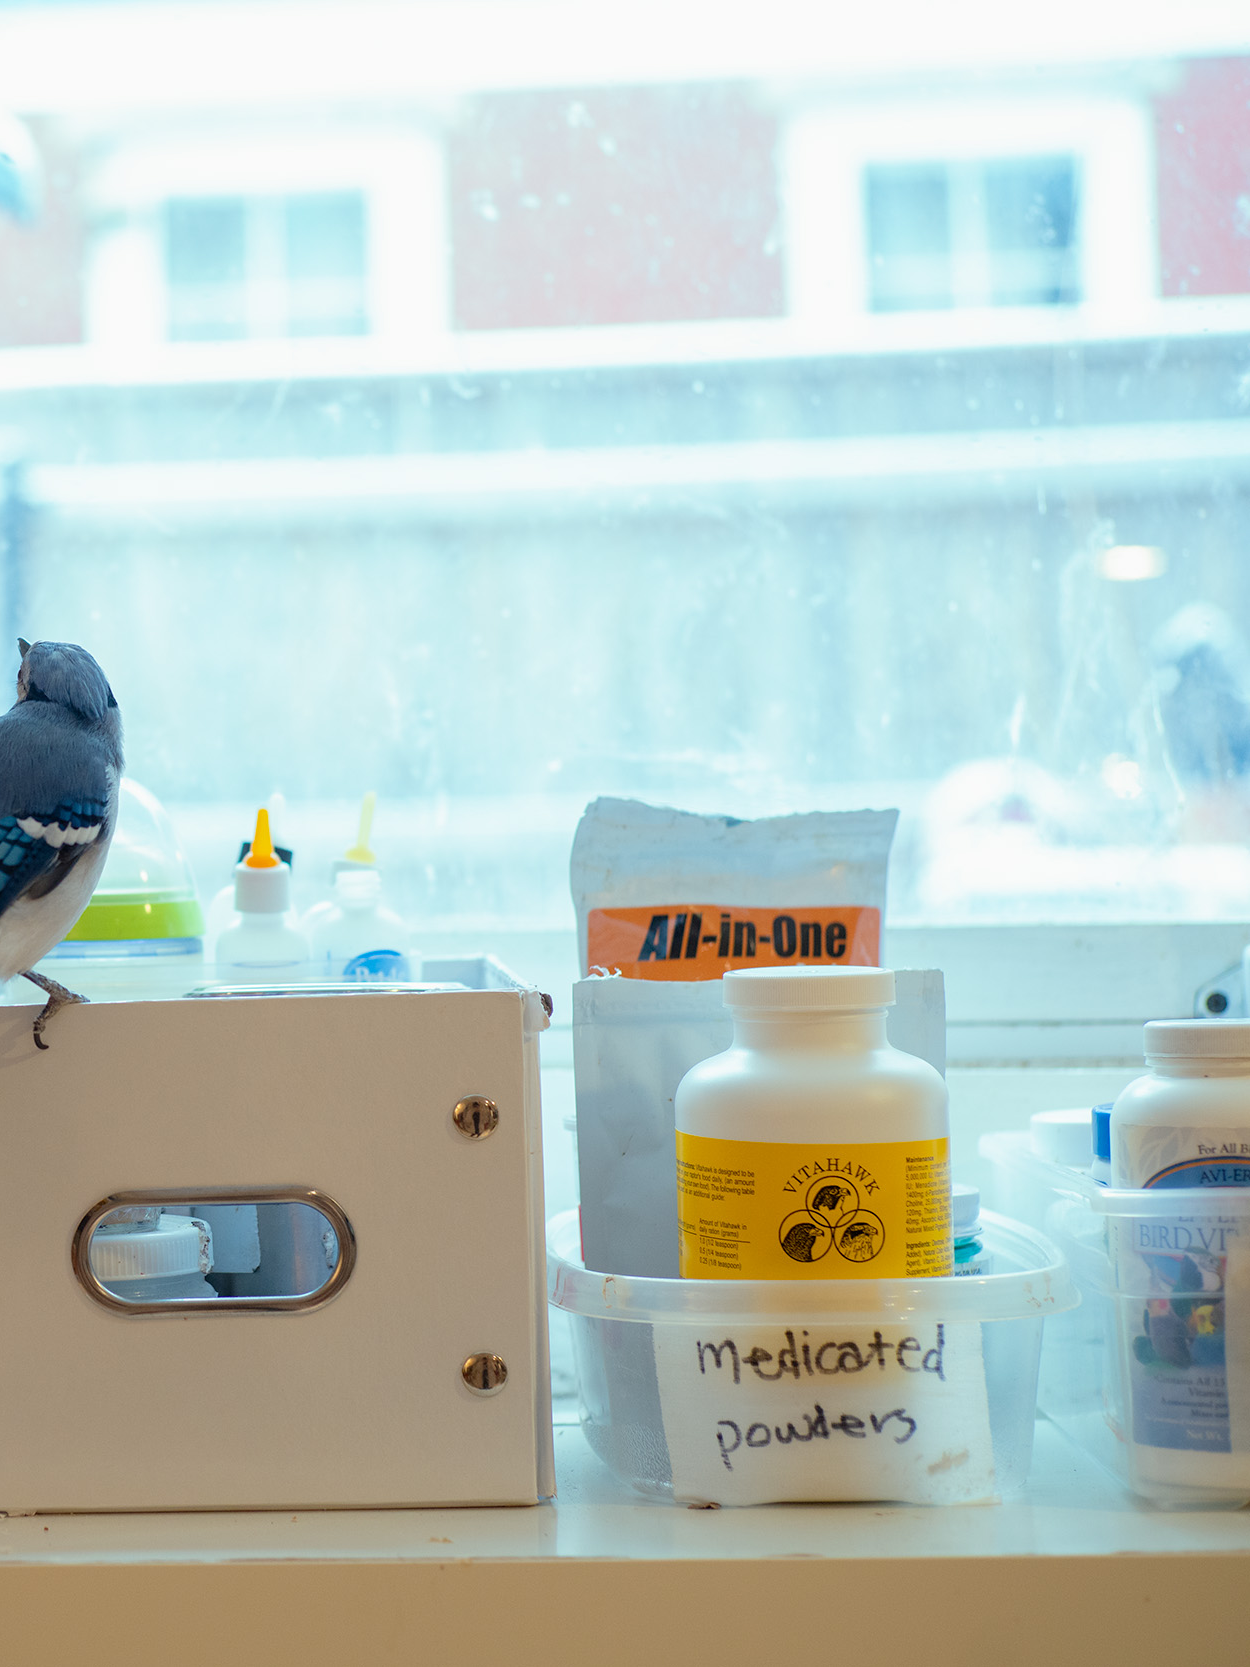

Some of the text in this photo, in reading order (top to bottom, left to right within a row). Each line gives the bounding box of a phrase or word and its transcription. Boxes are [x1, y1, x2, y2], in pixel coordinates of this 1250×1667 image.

[637, 913, 847, 962] All-in-One
[1197, 1144, 1216, 1155] For
[1220, 1143, 1237, 1154] All
[718, 1168, 740, 1177] designed
[747, 1170, 755, 1178] be
[782, 1157, 880, 1197] VITAHAWK
[734, 1179, 755, 1187] amount
[711, 1183, 720, 1192] The
[720, 1185, 741, 1196] following
[742, 1187, 755, 1196] table
[1139, 1224, 1192, 1250] BIRD
[715, 1240, 739, 1251] teaspoon)
[715, 1250, 739, 1261] teaspoon)
[717, 1260, 742, 1271] teaspoon)
[716, 1401, 917, 1472] powders
